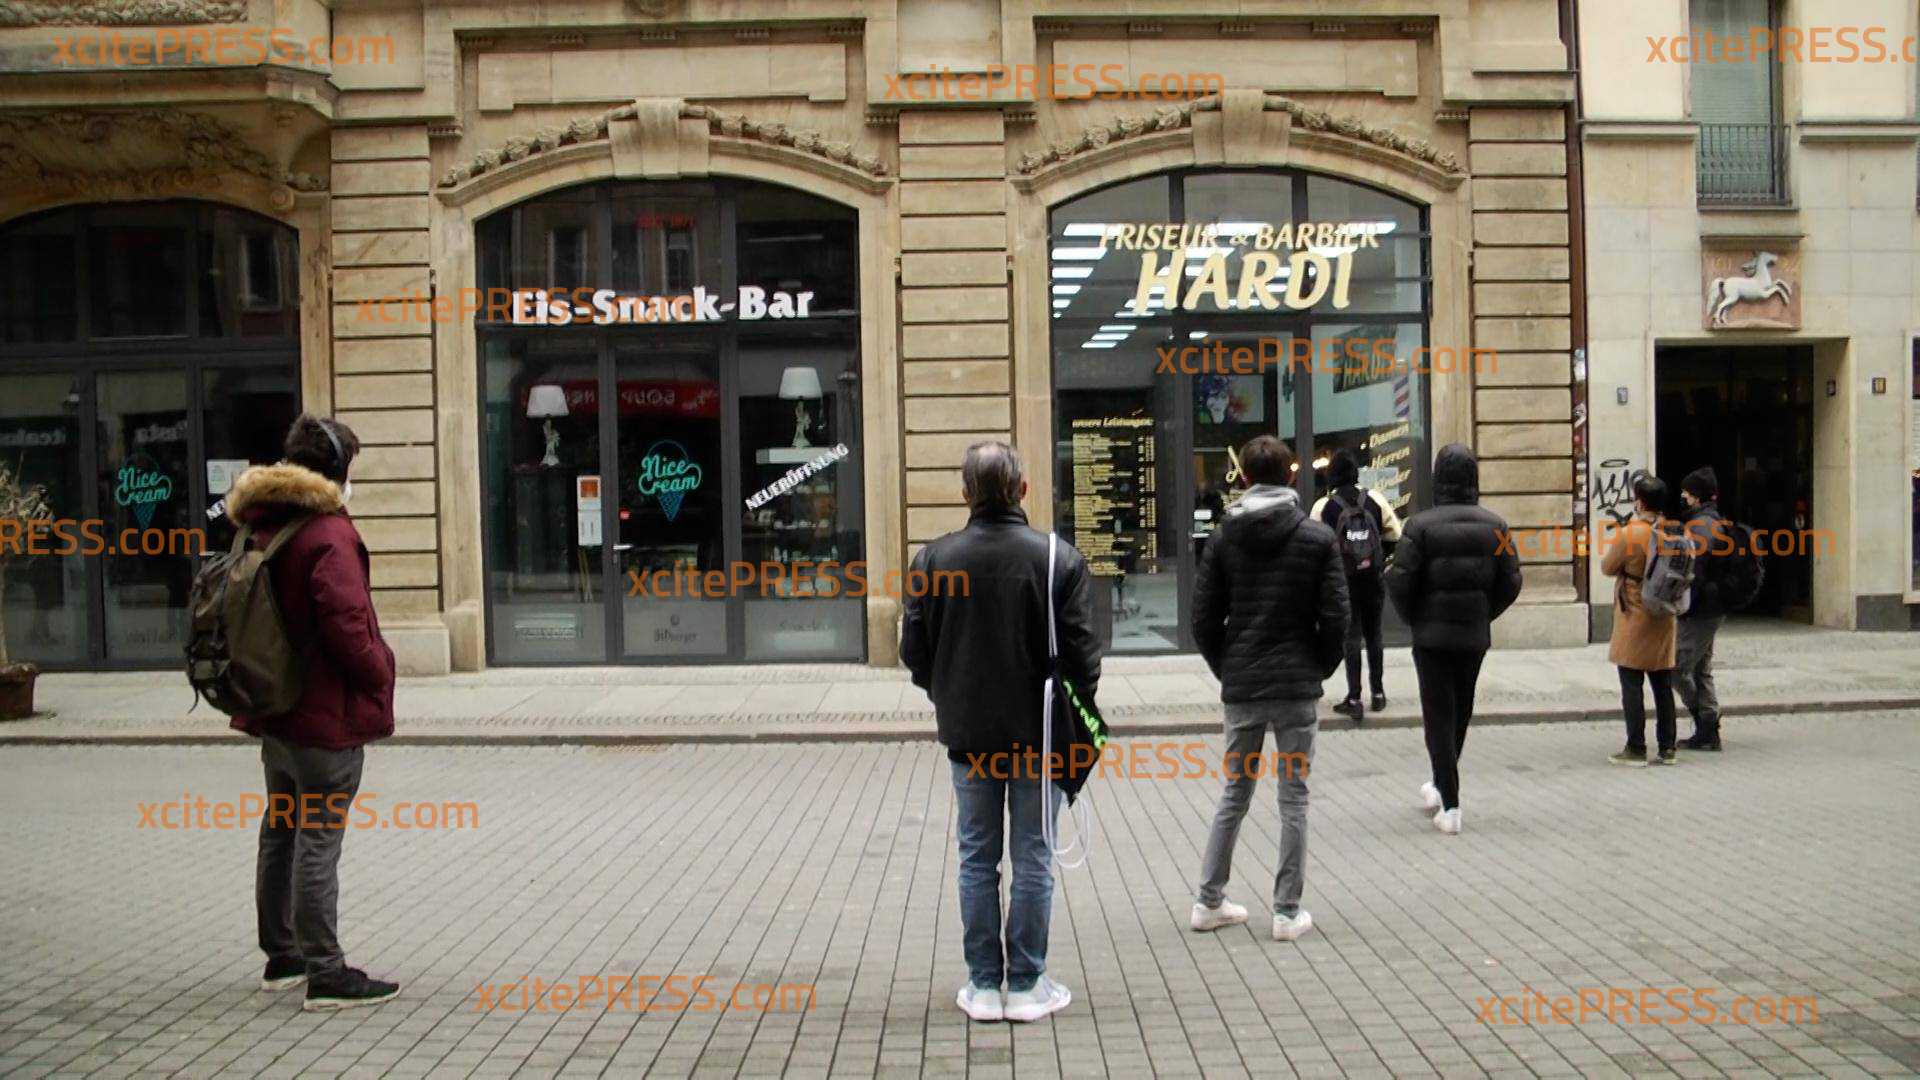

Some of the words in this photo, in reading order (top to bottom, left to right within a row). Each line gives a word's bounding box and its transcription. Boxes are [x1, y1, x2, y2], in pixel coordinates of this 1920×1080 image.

[1099, 222, 1219, 250] FRISEUR
[1229, 230, 1249, 246] &
[1255, 222, 1379, 250] BARBIER
[1131, 249, 1353, 315] HARDI
[512, 285, 814, 325] Eis-Snack-Bar
[118, 465, 160, 490] Nice
[638, 464, 702, 495] Cream
[641, 454, 688, 482] Nice
[115, 475, 172, 507] Cream
